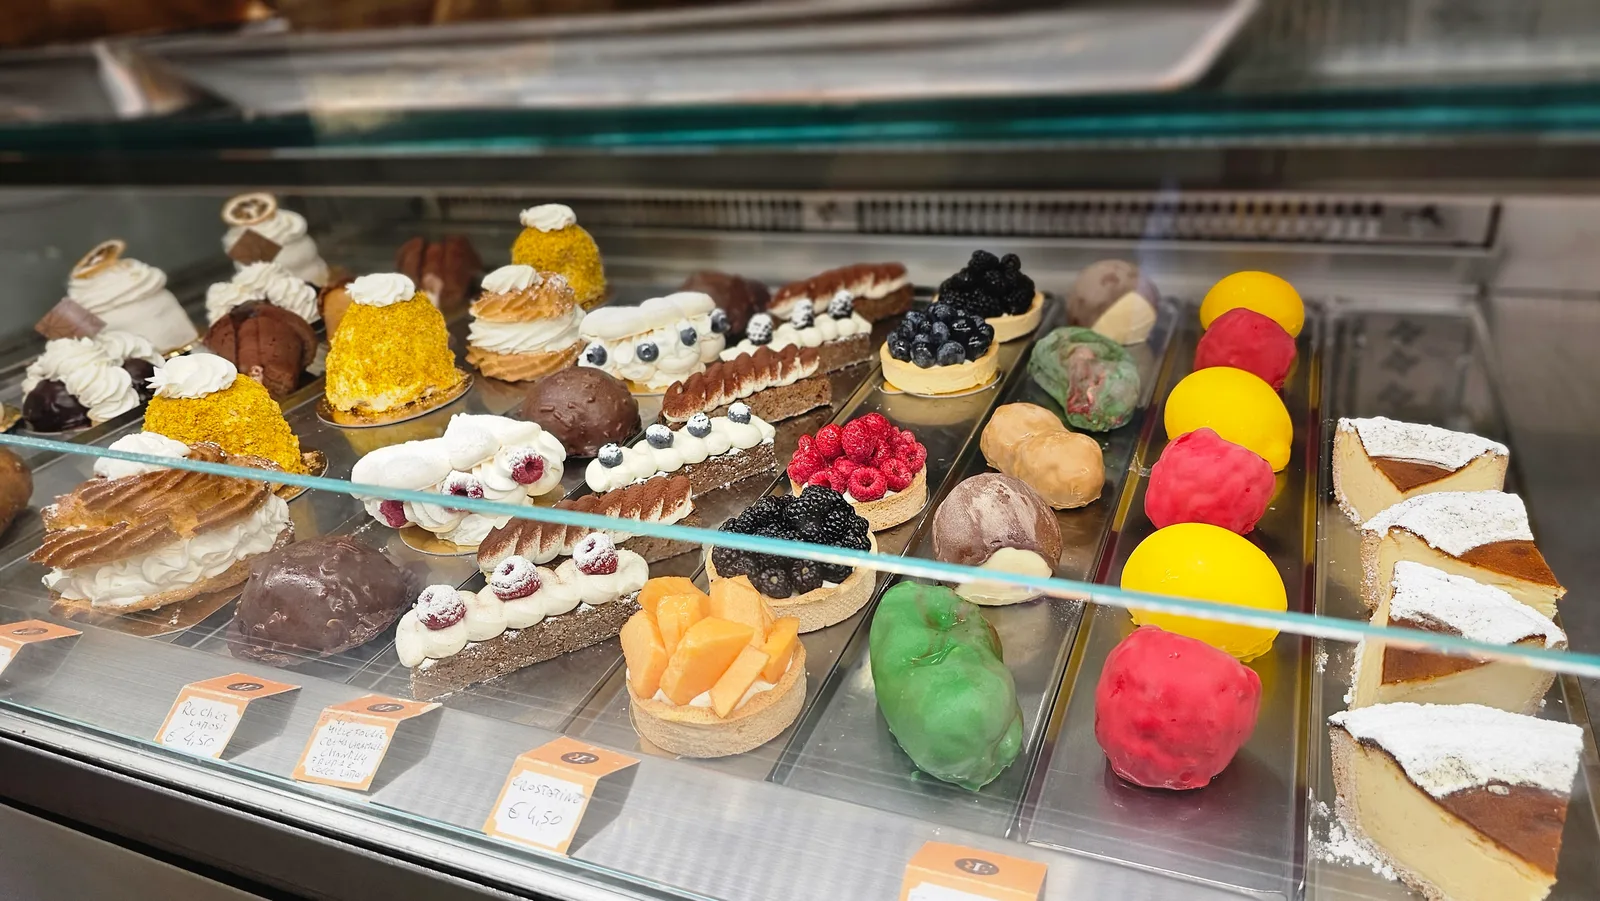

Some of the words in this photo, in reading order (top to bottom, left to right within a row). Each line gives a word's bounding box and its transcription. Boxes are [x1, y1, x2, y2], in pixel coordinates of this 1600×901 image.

[165, 727, 184, 742] €
[184, 731, 215, 746] 4,50
[508, 802, 526, 819] €
[528, 806, 562, 826] 4,50
